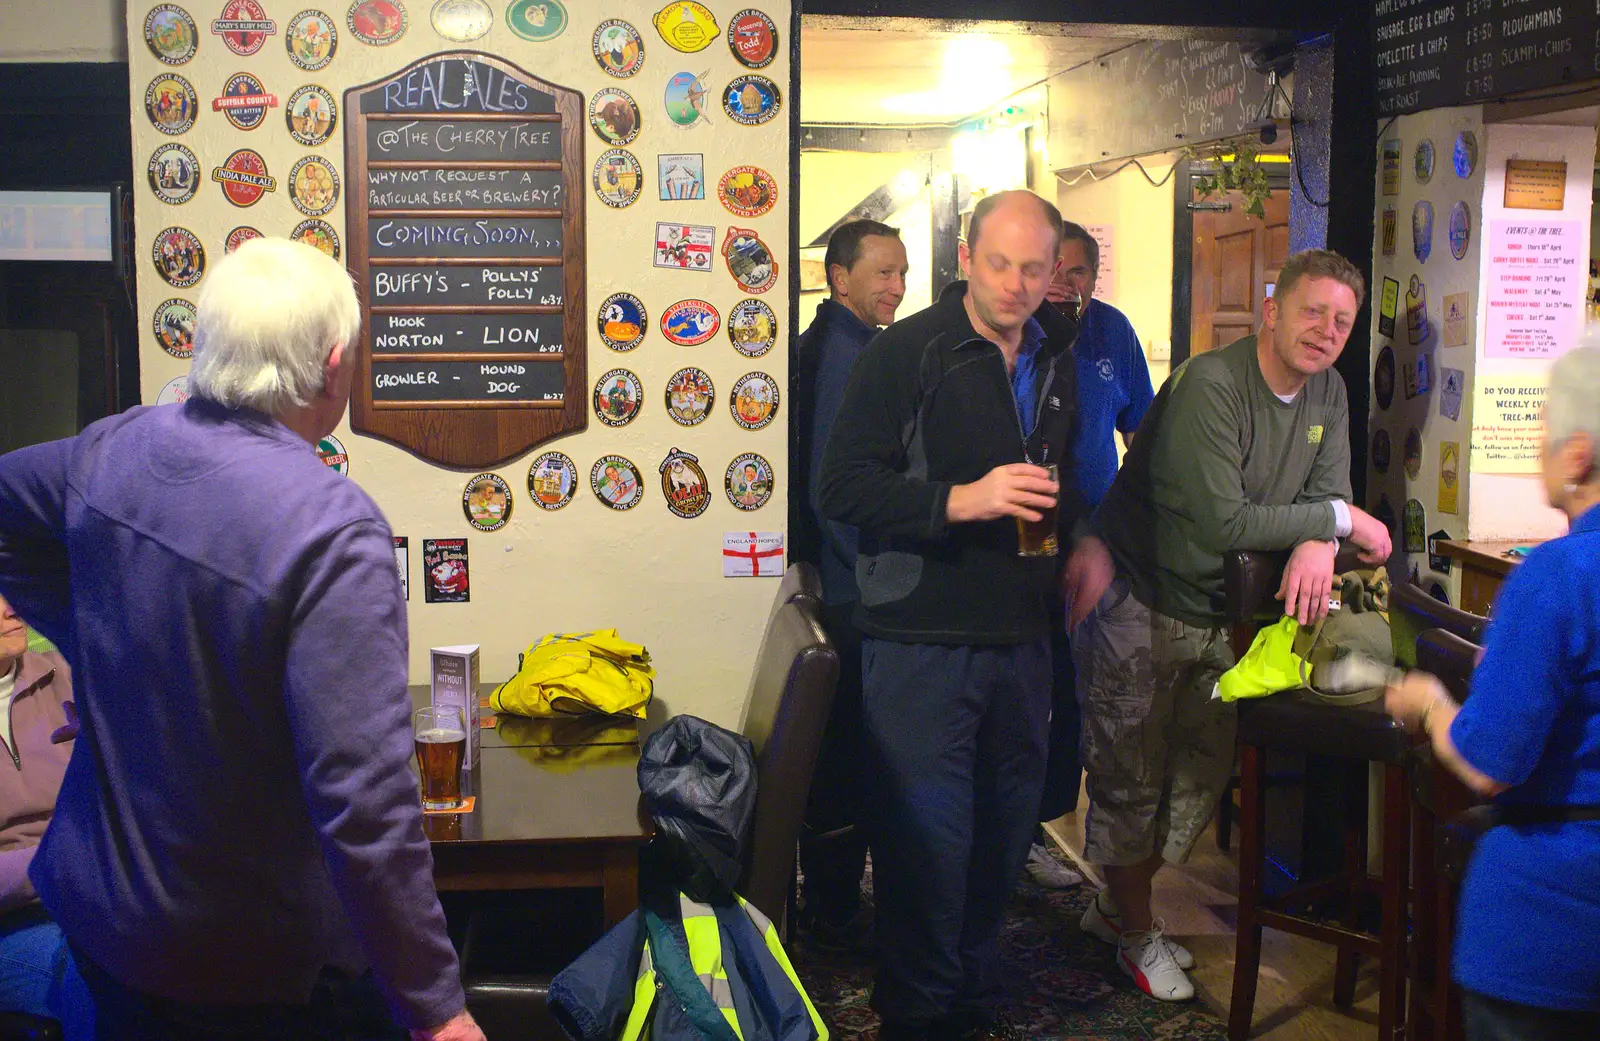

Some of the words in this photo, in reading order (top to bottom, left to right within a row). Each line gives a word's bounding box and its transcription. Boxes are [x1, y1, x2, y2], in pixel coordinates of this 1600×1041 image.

[146, 5, 166, 40] NETHERGATE
[167, 5, 194, 26] BREWERY
[660, 3, 682, 24] LEMON
[691, 4, 712, 21] HEAD
[1434, 6, 1454, 24] CHIPS
[1502, 6, 1562, 36] PLOUGHMANS
[216, 22, 240, 30] MARY'S
[240, 22, 256, 30] RUBY
[256, 22, 272, 30] MILD
[288, 10, 318, 36] NETHERGATE
[320, 11, 337, 40] BREWERY
[728, 10, 750, 43] NETHERGATE
[751, 10, 774, 30] BREWERY
[594, 20, 612, 56] NETHERGATE
[613, 20, 638, 39] BREWERY
[738, 36, 760, 50] Todd
[288, 52, 304, 70] JOLLY
[306, 55, 332, 70] FARMER
[1377, 44, 1416, 68] OMELETTE
[1428, 36, 1448, 54] CHIPS
[1501, 44, 1537, 66] SCAMPI
[1545, 38, 1572, 57] CHIPS
[604, 66, 632, 78] LOUNGE
[632, 52, 644, 74] LIZARD
[146, 75, 172, 104] NETHERGATE
[174, 75, 196, 100] BREWERY
[385, 62, 462, 110] REAL
[463, 62, 528, 112] ALES
[730, 76, 747, 90] HOLY
[748, 76, 772, 87] SMOKE
[217, 96, 246, 106] SUFFOLK
[246, 95, 273, 104] COUNTY
[288, 86, 318, 110] NETHERGATE
[590, 90, 608, 125] NETHERGATE
[608, 89, 634, 106] BREWERY
[1396, 90, 1420, 108] ROAST
[724, 104, 758, 126] NETHERGATE
[758, 102, 780, 124] BREWERY
[154, 118, 194, 135] AZZAPARROT
[292, 130, 310, 145] DIRTY
[312, 134, 328, 146] DICK
[436, 124, 508, 152] CHERRY
[510, 123, 551, 149] TREE
[149, 144, 179, 171] NETHERGATE
[180, 144, 200, 172] BREWERY
[228, 153, 265, 176] NETHERGATE
[594, 149, 621, 177] NETHERGATE
[622, 151, 642, 176] BREWERY
[218, 170, 240, 180] INDIA
[240, 174, 257, 184] PALE
[258, 176, 273, 187] ALE
[290, 156, 319, 184] NETHERGATE
[320, 157, 339, 184] BREWERY
[368, 170, 397, 185] WHY
[400, 170, 429, 182] NOT
[436, 170, 510, 184] REQUEST
[520, 171, 532, 185] A
[720, 167, 755, 197] NETHERGATE
[757, 170, 777, 204] BREWERY
[323, 196, 336, 213] DROP
[369, 190, 430, 207] PARTICULAR
[433, 191, 464, 206] BEER
[465, 190, 480, 200] OR
[484, 185, 562, 206] BREWERY?
[596, 190, 616, 208] BARFLY
[618, 188, 640, 208] SPECIAL
[722, 200, 750, 216] PAINTED
[752, 204, 770, 216] LADY
[320, 221, 338, 247] BREWERY
[376, 220, 468, 247] COMING
[1506, 226, 1528, 235] EVENTS
[154, 228, 176, 261] NETHERGATE
[176, 228, 202, 250] BREWERY
[376, 270, 448, 296] BUFFY'S
[482, 267, 542, 283] POLLYS'
[747, 286, 766, 294] ESSEX
[488, 287, 533, 300] FOLLY
[389, 316, 426, 328] HOOK
[376, 334, 444, 348] NORTON
[483, 326, 540, 345] LION
[600, 332, 612, 347] JACK
[732, 340, 750, 356] YOUNG
[752, 337, 774, 357] HOWLER
[376, 371, 440, 388] GROWLER
[480, 364, 526, 375] HOUND
[487, 382, 520, 394] DOG
[1484, 387, 1494, 395] DO
[1497, 387, 1516, 395] YOU
[1496, 400, 1530, 408] WEEKLY
[597, 411, 609, 424] OLD
[610, 418, 630, 427] CHAP
[692, 413, 707, 426] BEST
[730, 404, 750, 429] DRUNKEN
[750, 415, 773, 430] MONKEY
[326, 455, 345, 466] BEER
[530, 489, 544, 508] ROYAL
[545, 496, 572, 510] SERVICE
[629, 486, 643, 507] GOLDS
[672, 484, 702, 502] OLD
[726, 488, 736, 505] LORD
[758, 490, 771, 508] RINGS
[470, 519, 505, 532] LIGHTNING
[438, 674, 464, 684] WITHOUT
